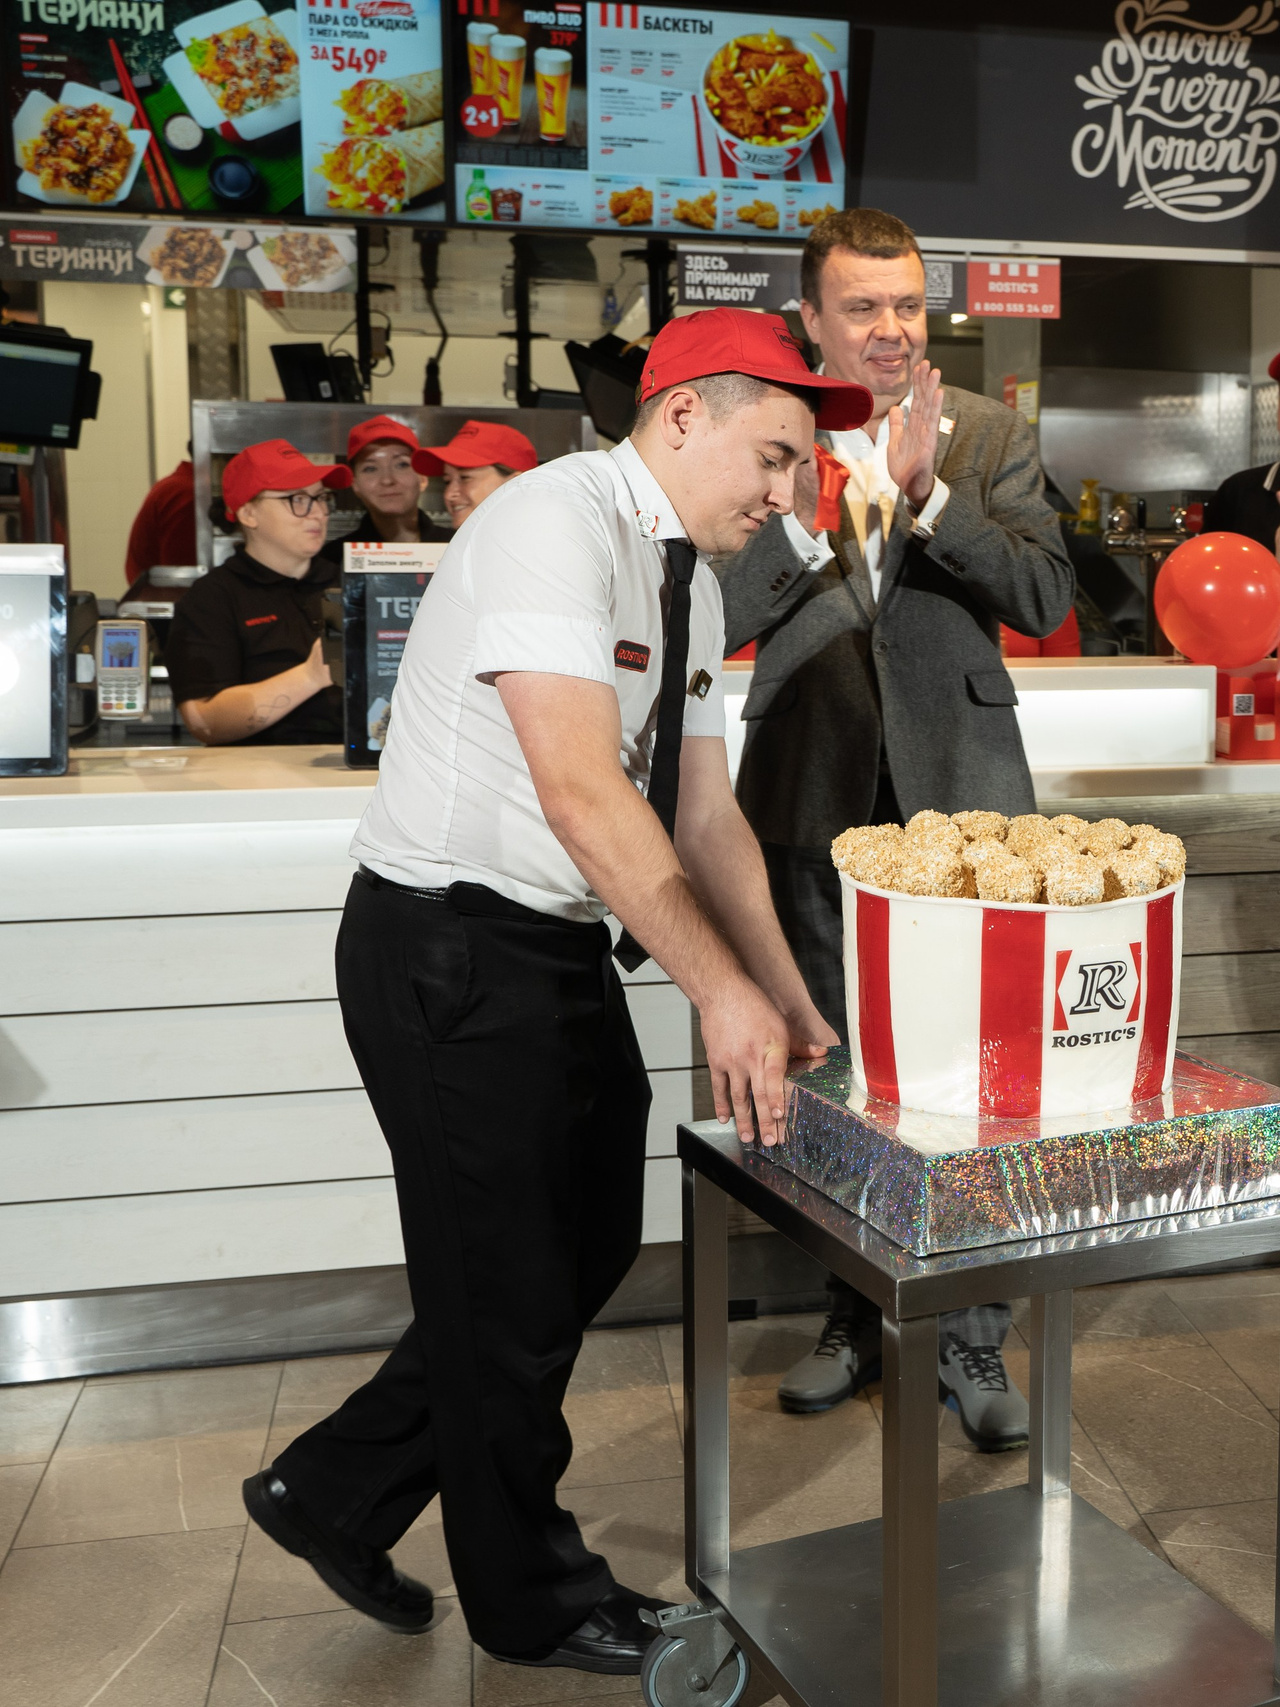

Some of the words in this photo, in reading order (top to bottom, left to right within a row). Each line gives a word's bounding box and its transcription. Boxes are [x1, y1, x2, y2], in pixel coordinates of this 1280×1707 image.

[308, 13, 339, 26] ПАРА
[343, 15, 358, 27] СО
[361, 16, 418, 31] СКИДКОЙ
[557, 13, 582, 26] BUD
[643, 15, 713, 35] БАСКЕТЫ
[309, 28, 314, 36] 2
[316, 29, 338, 38] МЕГА
[1102, 0, 1252, 88] Savour
[1126, 64, 1253, 138] Every
[465, 105, 499, 128] 2+1
[10, 243, 134, 276] ТЕРИЯКИ
[685, 255, 729, 271] ЗДЕСЬ
[685, 271, 770, 287] ПРИНИМАЮТ
[988, 281, 1039, 294] ROSTIC'S
[685, 286, 705, 300] НА
[706, 287, 756, 302] РАБОТУ
[617, 648, 648, 666] ROSTIC'S
[1069, 960, 1128, 1015] R
[1051, 1026, 1137, 1048] ROSTIC'S
